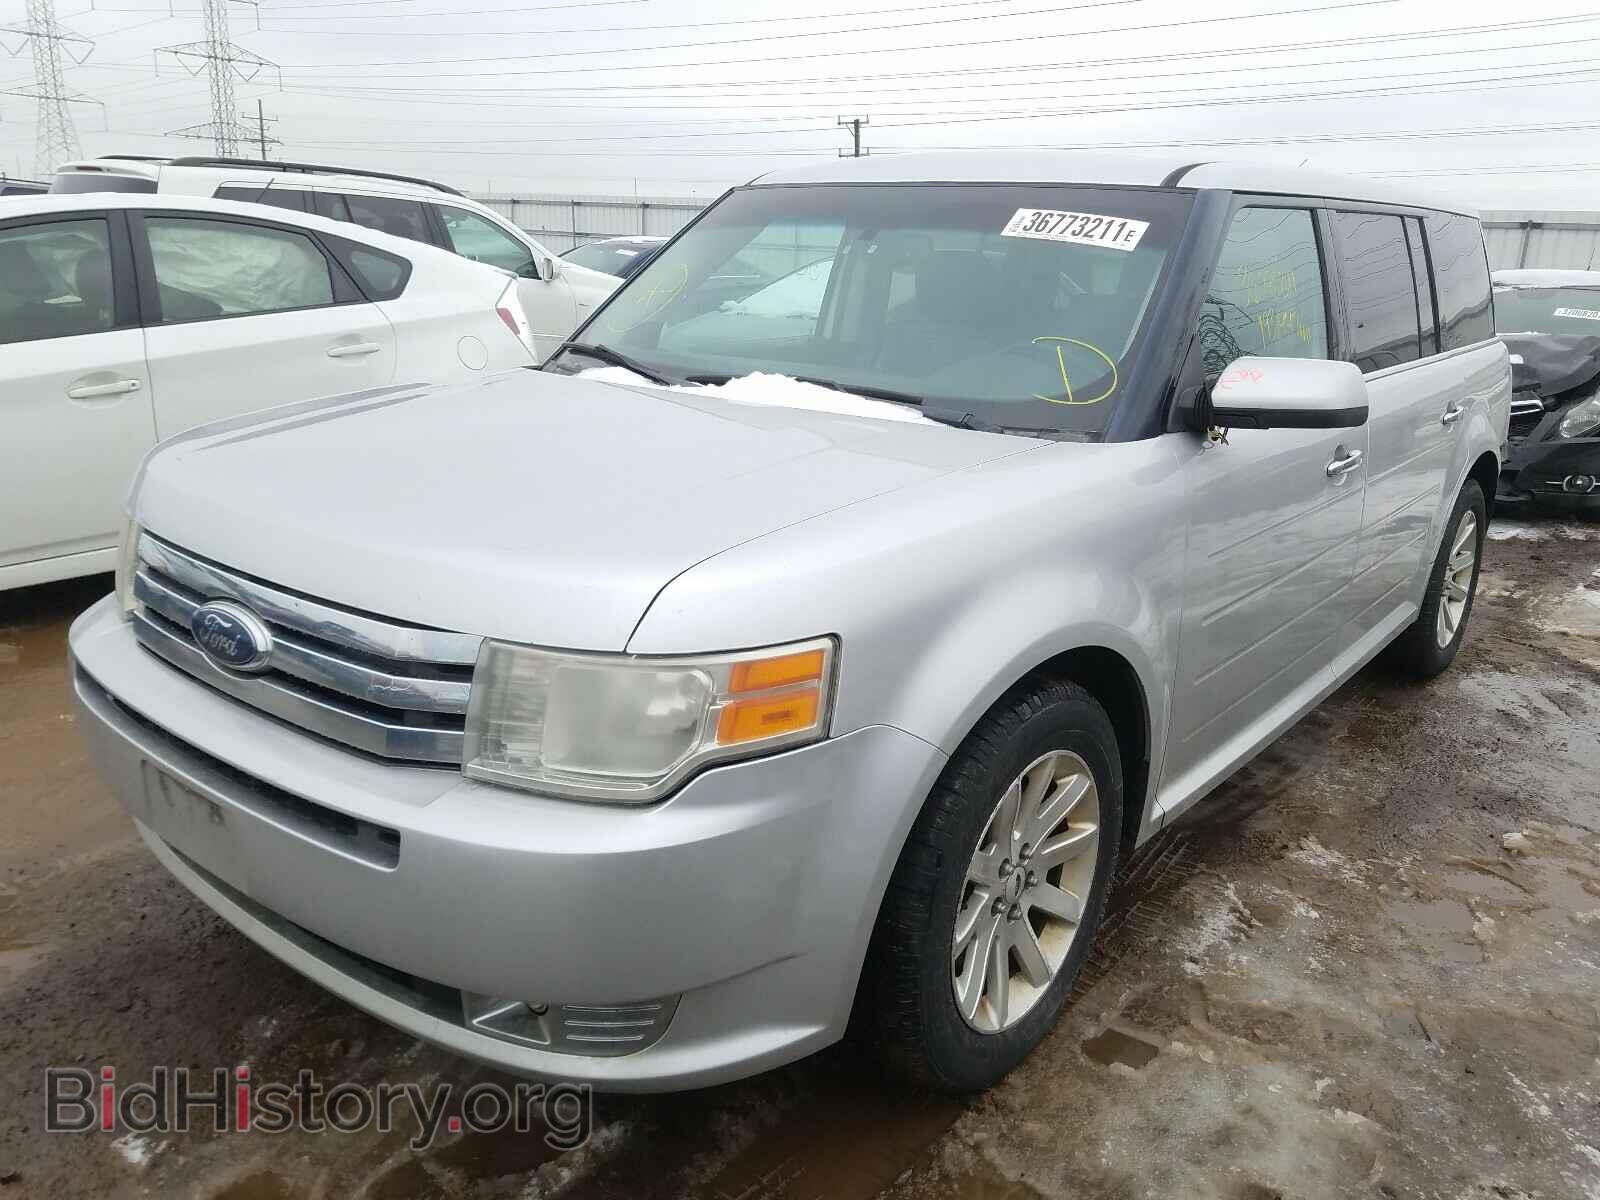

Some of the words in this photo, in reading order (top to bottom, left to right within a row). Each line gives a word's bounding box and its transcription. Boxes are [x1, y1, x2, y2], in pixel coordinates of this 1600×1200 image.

[1023, 211, 1128, 242] 36773211
[1124, 229, 1137, 242] E
[203, 613, 241, 657] Ford
